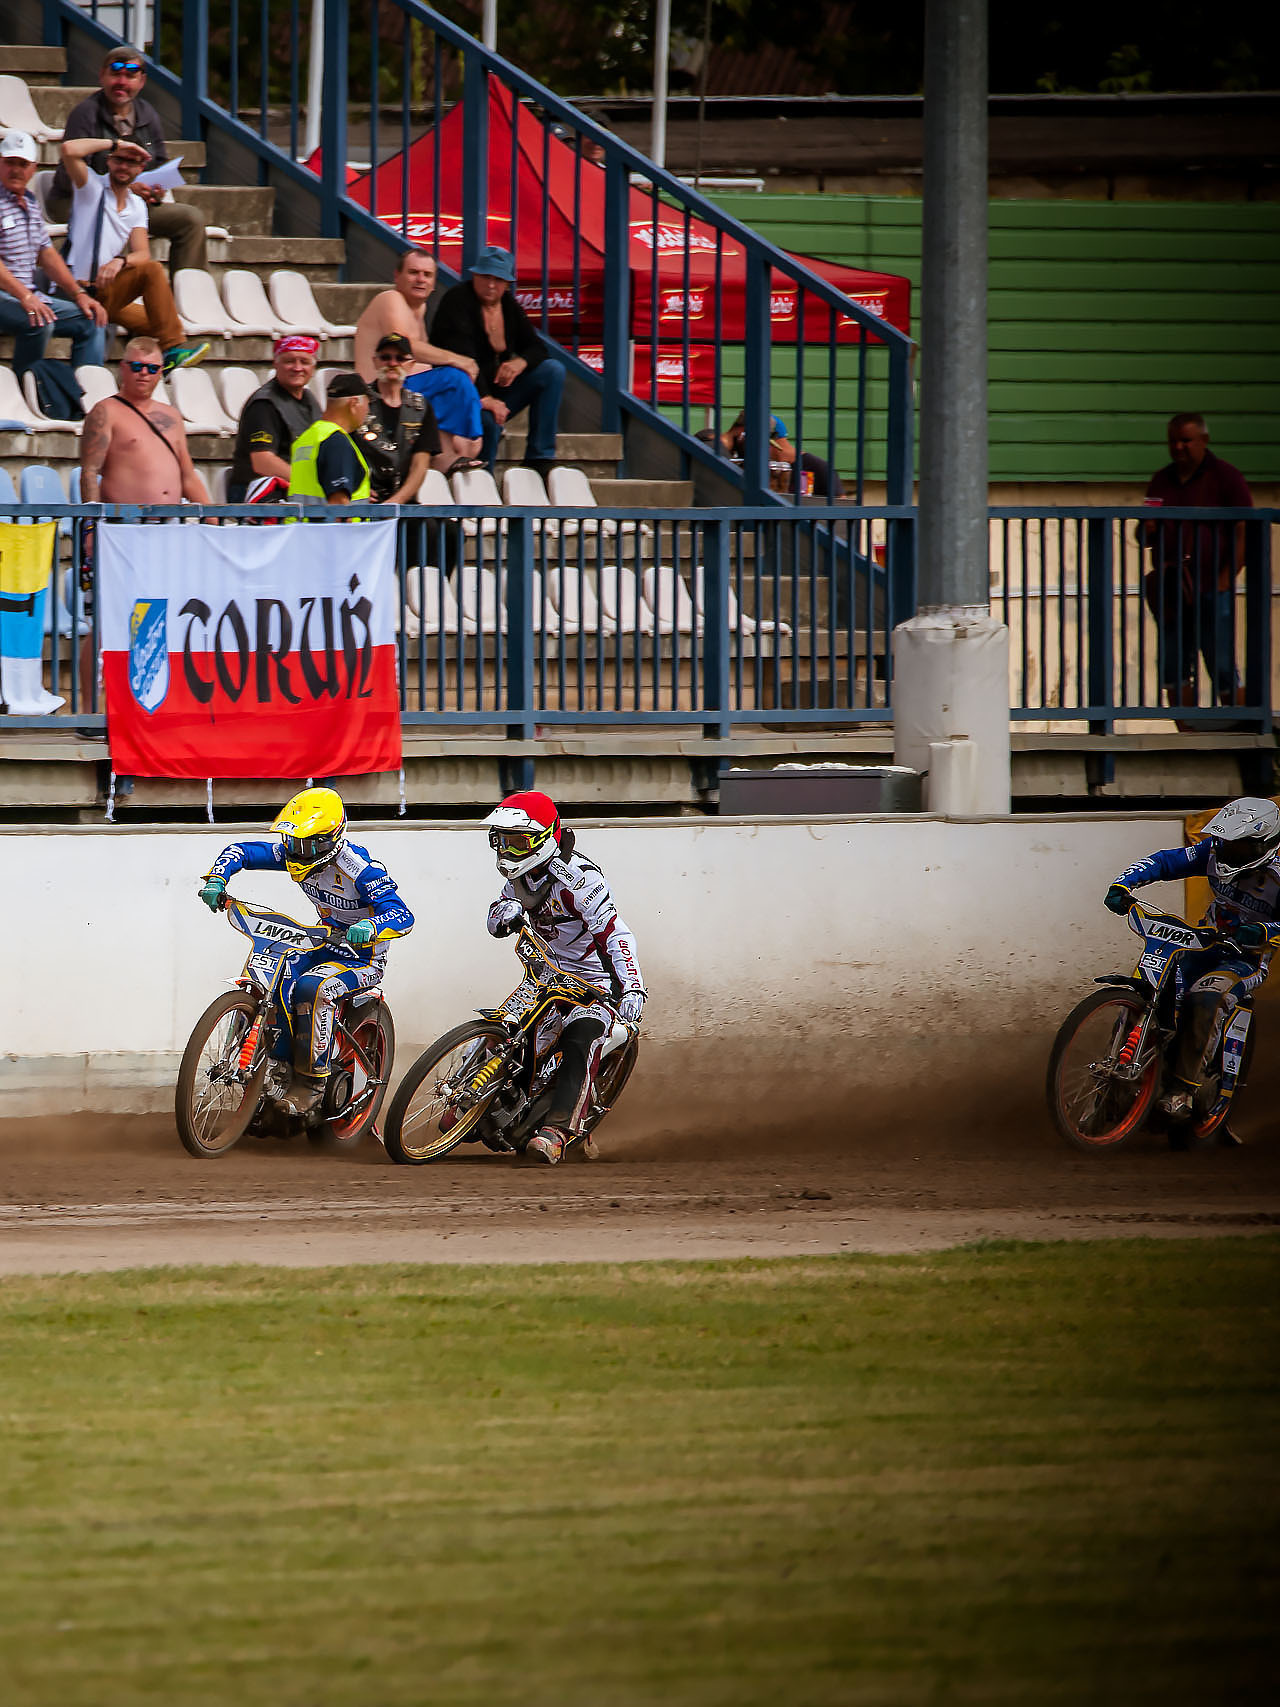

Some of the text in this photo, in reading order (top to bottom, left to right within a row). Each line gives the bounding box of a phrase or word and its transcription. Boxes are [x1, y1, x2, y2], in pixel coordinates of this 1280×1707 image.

[178, 573, 374, 705] TORUŃ
[254, 921, 305, 946] LAVOR
[251, 954, 278, 968] FST
[1143, 954, 1167, 969] FST
